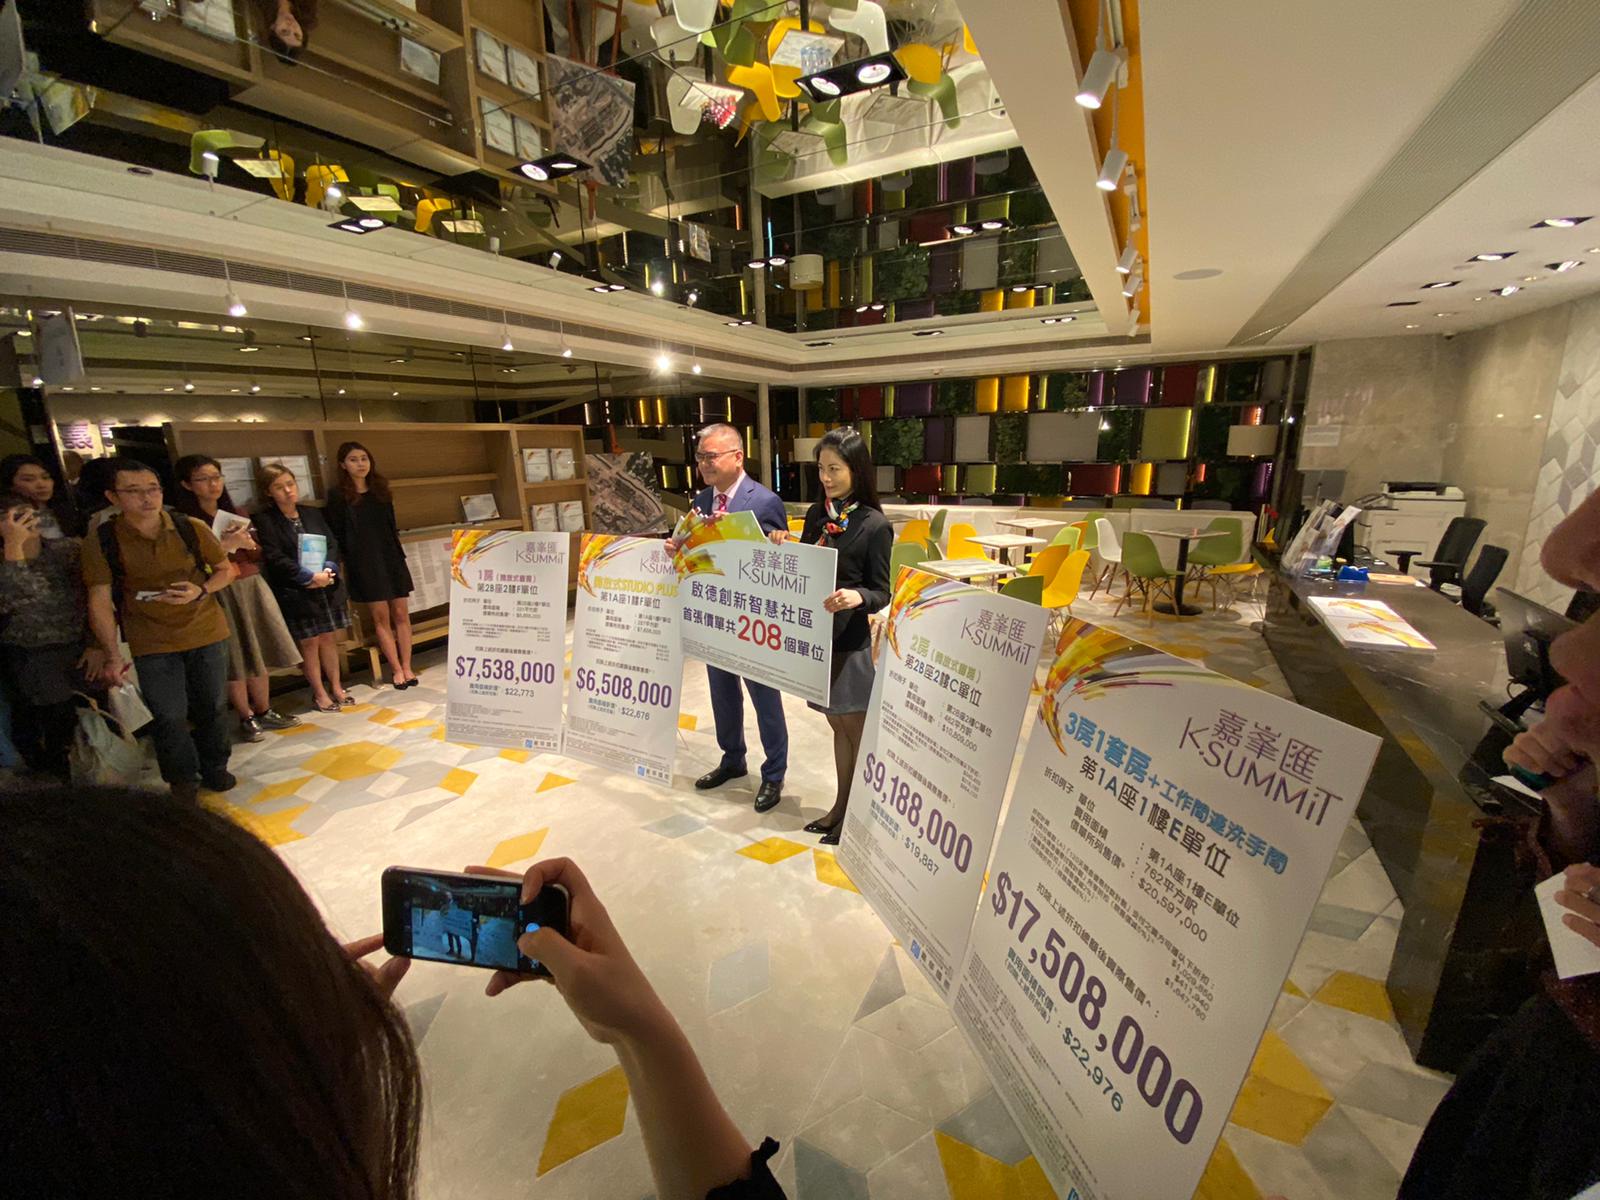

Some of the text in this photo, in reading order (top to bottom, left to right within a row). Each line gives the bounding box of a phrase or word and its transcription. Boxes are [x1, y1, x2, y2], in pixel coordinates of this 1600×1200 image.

[752, 549, 799, 576] 嘉峯匯
[976, 608, 1028, 643] 嘉峯匯
[455, 655, 556, 685] $7,538,000
[576, 666, 673, 709] $6,508,000
[1212, 708, 1323, 785] 嘉峯匯
[863, 751, 974, 874] $9,188,000
[1079, 755, 1232, 879] 第1A座1樓E單位
[904, 836, 940, 877] $19,887
[1148, 847, 1241, 929] 第1A座1樓E單位
[1137, 876, 1208, 943] $20,597,000
[991, 870, 1204, 1145] $17,508,000
[1062, 1027, 1124, 1113] $22,976
